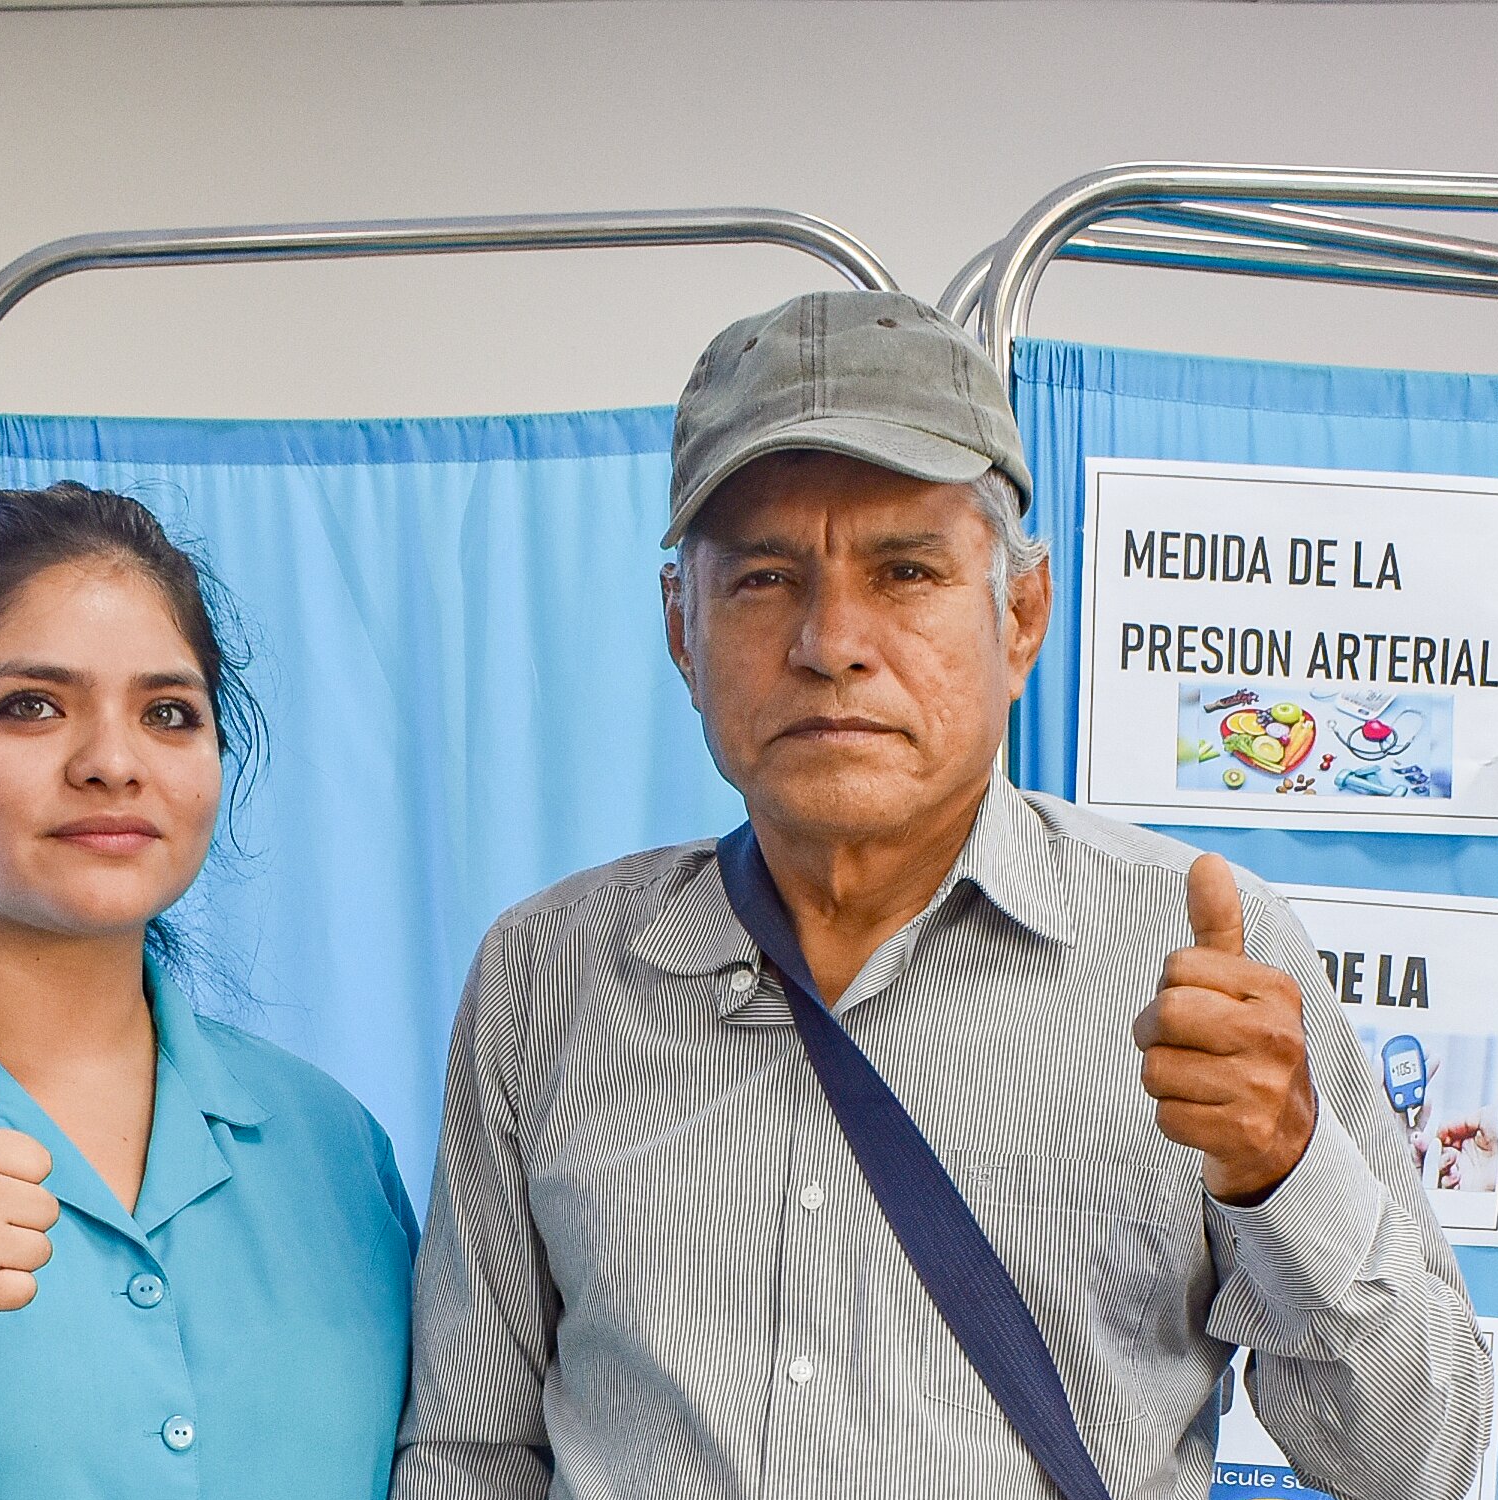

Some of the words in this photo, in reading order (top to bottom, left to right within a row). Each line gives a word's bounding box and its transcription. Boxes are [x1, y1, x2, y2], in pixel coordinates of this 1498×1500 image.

[1123, 529, 1272, 585] MEDIDA
[1288, 536, 1339, 588] DE
[1352, 540, 1403, 591] LA
[1119, 622, 1292, 678] PRESION
[1376, 954, 1430, 1009] LA
